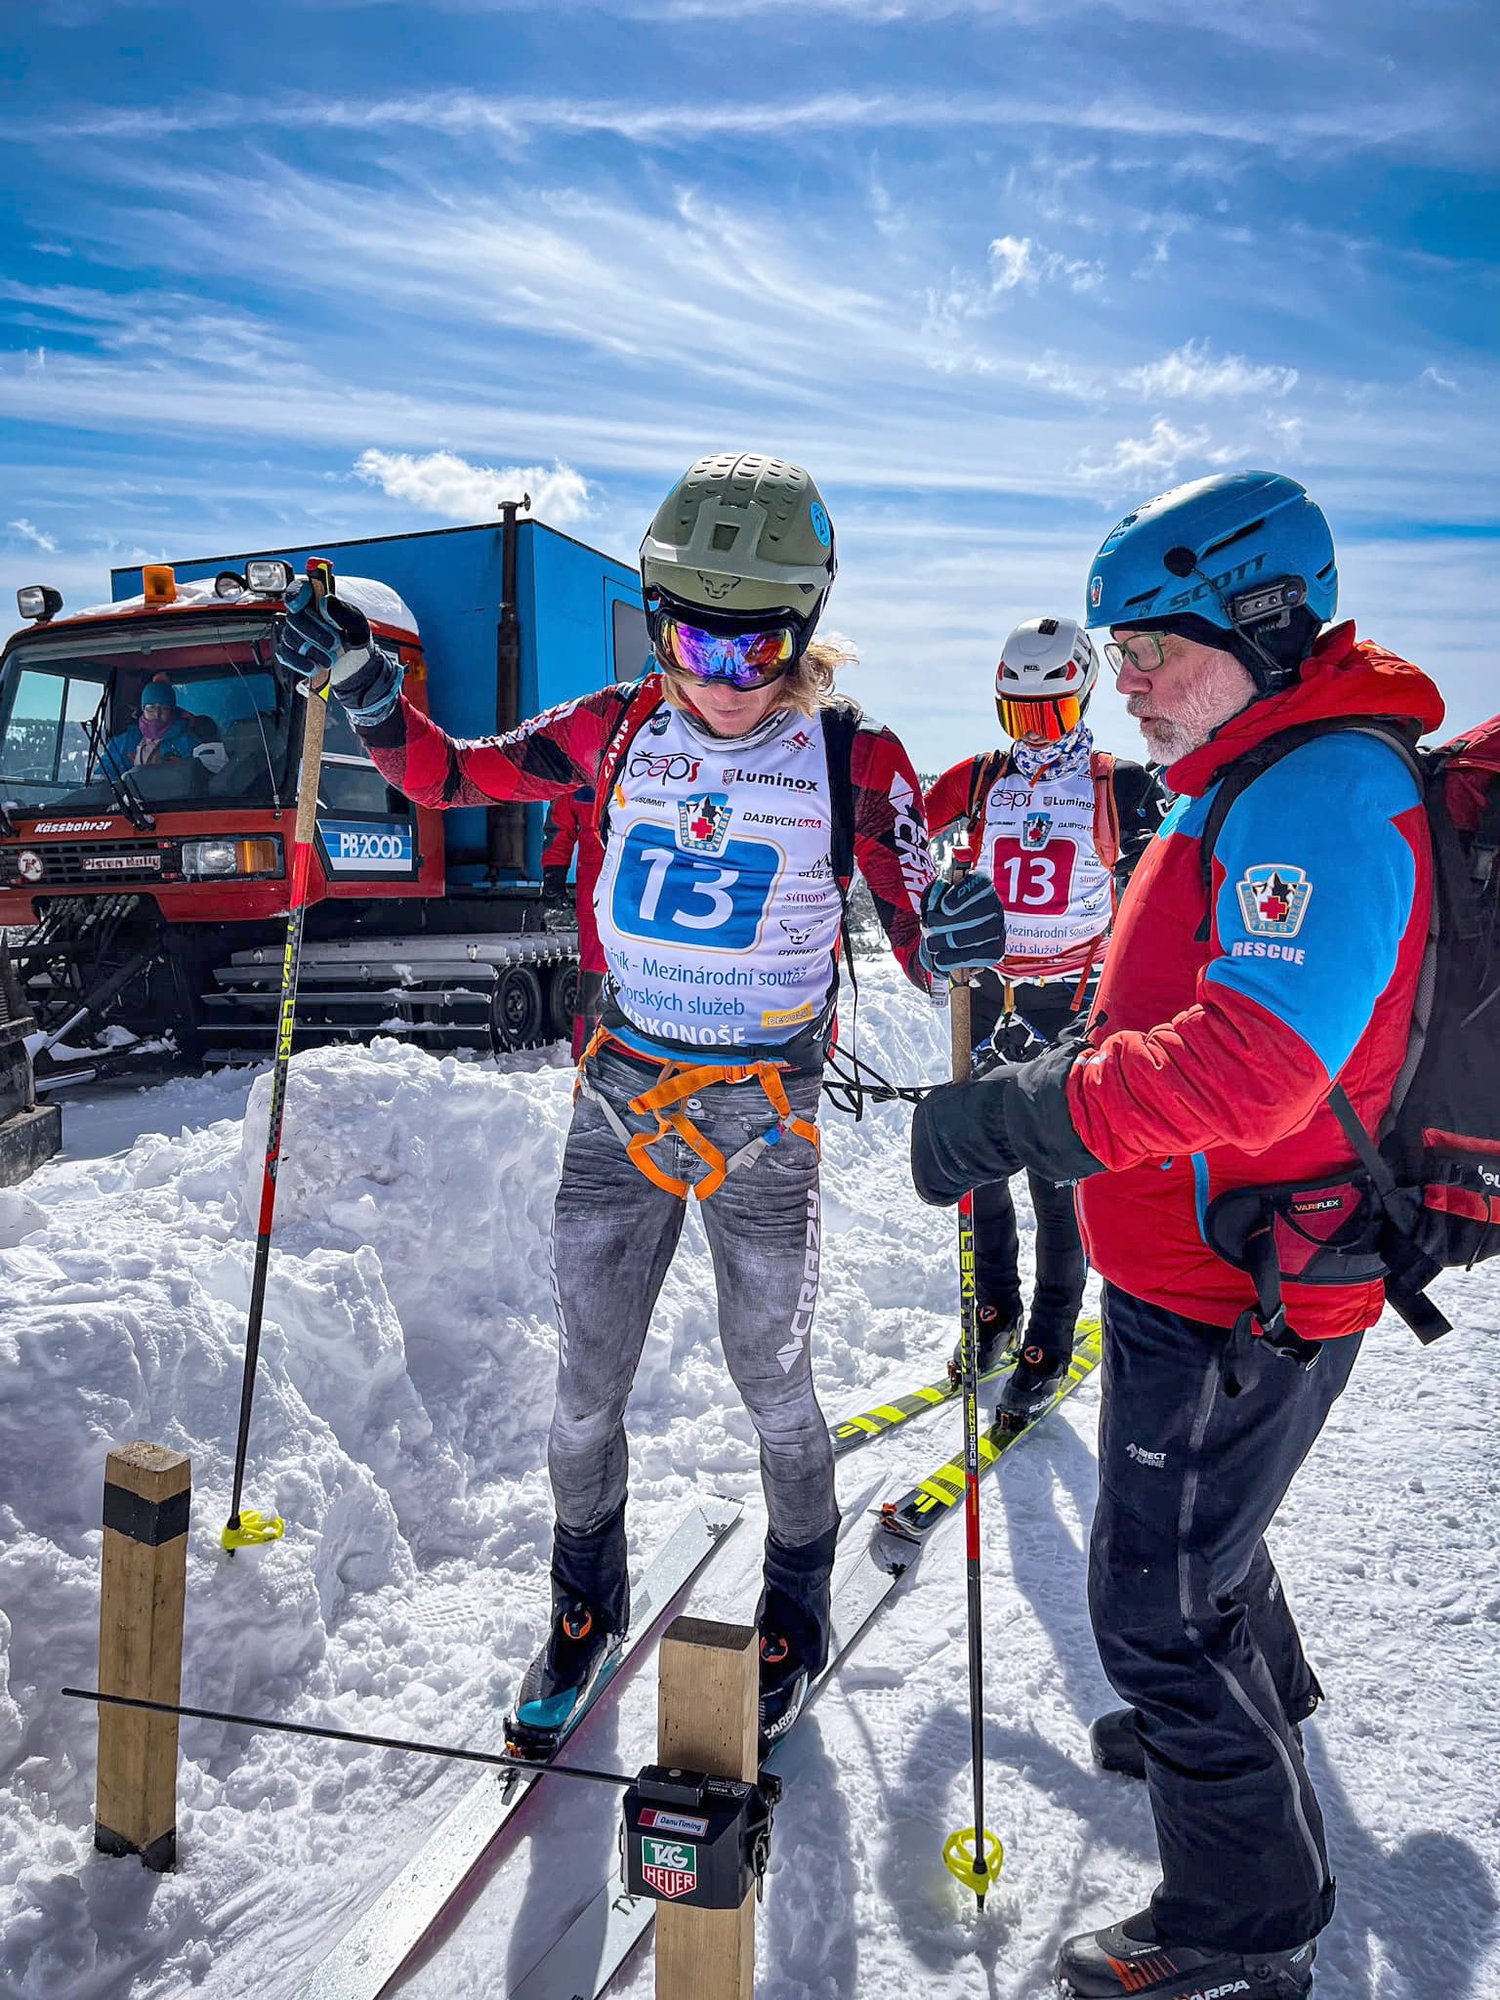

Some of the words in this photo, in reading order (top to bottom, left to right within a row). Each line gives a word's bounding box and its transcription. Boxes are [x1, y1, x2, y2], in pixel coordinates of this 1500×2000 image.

[1169, 552, 1268, 608] SCOTT
[736, 769, 819, 792] Luminox
[34, 820, 112, 833] Kässbohrer
[742, 812, 796, 827] DAJBYCH
[639, 848, 740, 930] 13
[1003, 856, 1056, 906] 13
[1231, 941, 1306, 966] RESCUE
[642, 957, 754, 986] Mezinárodní
[758, 967, 807, 986] soutěž
[688, 995, 745, 1017] služeb
[278, 1000, 295, 1061] LEKI
[1295, 1199, 1340, 1213] VARIFLEX
[960, 1231, 975, 1298] LEKI
[650, 1841, 689, 1869] TAG
[646, 1867, 694, 1896] HEUER
